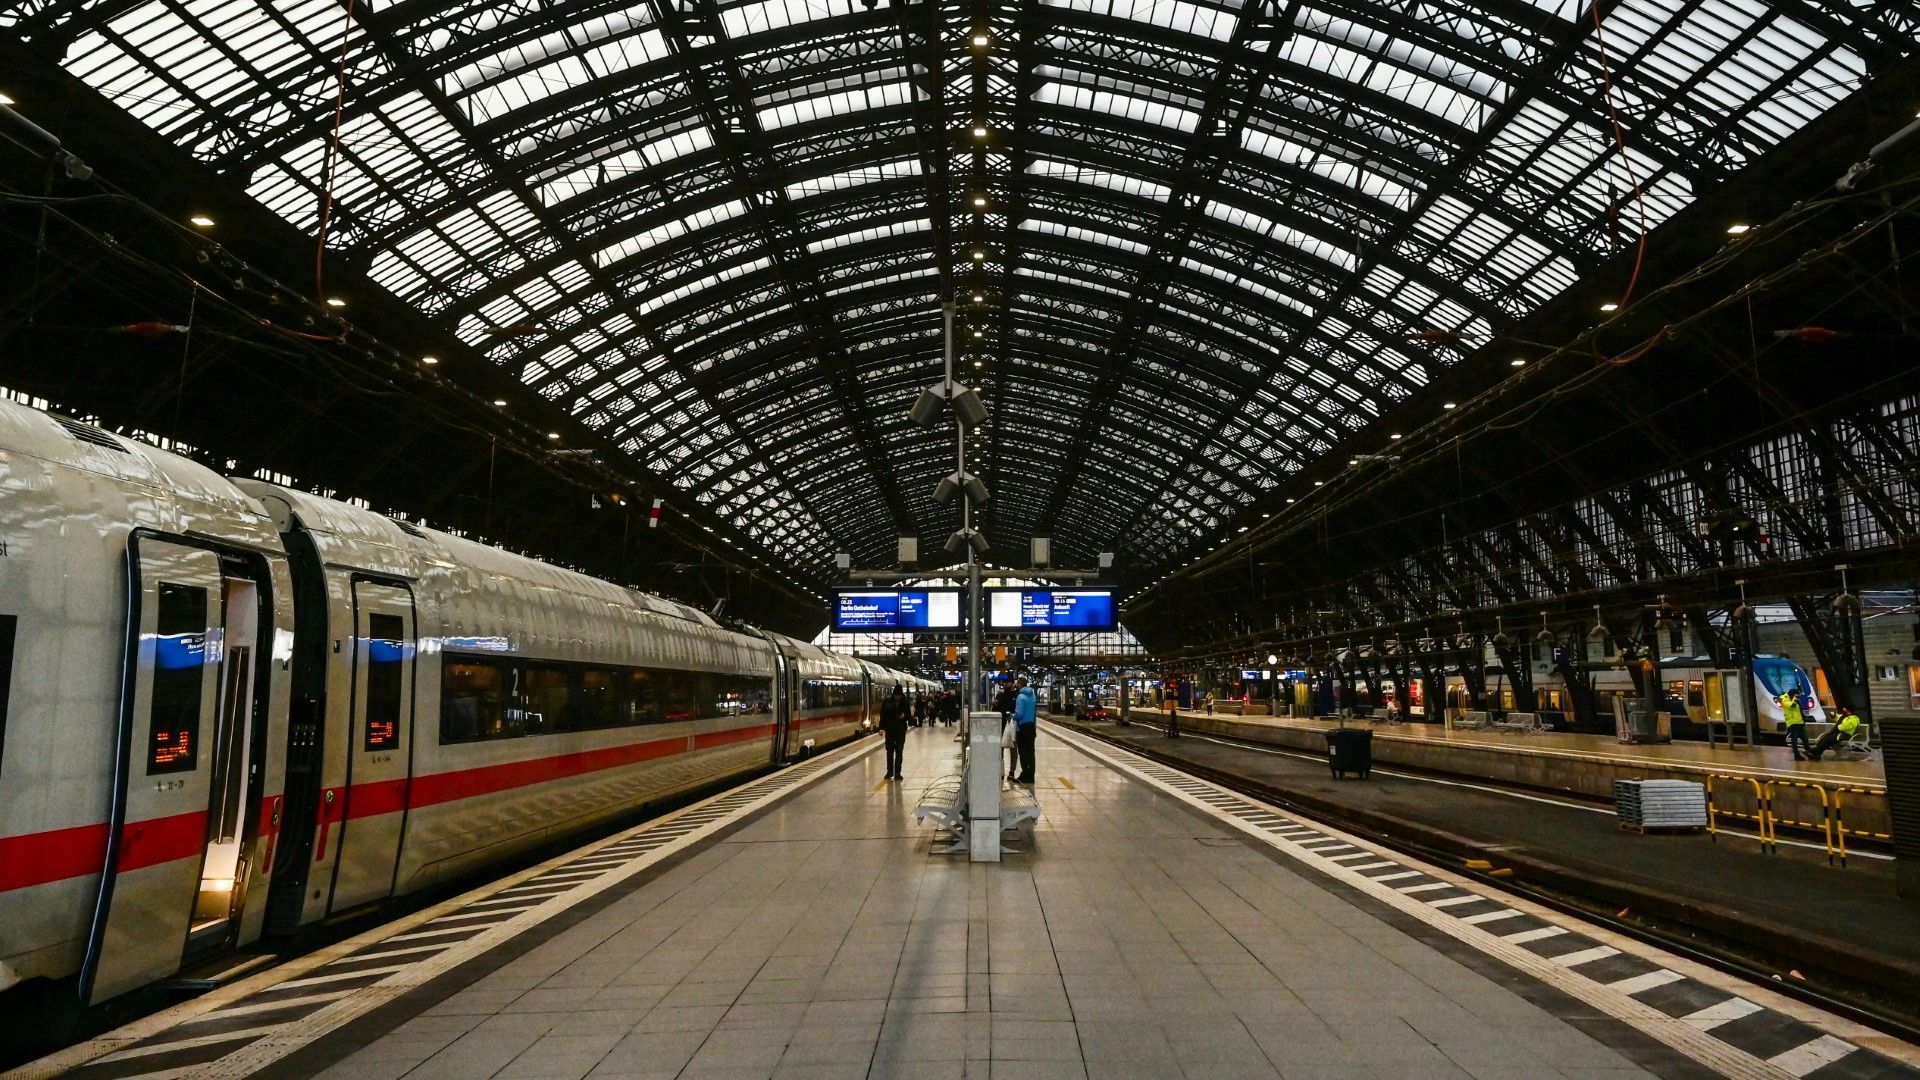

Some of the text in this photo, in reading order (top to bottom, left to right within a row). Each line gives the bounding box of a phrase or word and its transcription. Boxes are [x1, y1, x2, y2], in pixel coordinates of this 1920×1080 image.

[921, 648, 929, 661] F
[1023, 648, 1031, 660] F
[1553, 647, 1562, 660] F
[1728, 647, 1736, 660] F
[511, 667, 519, 697] 2
